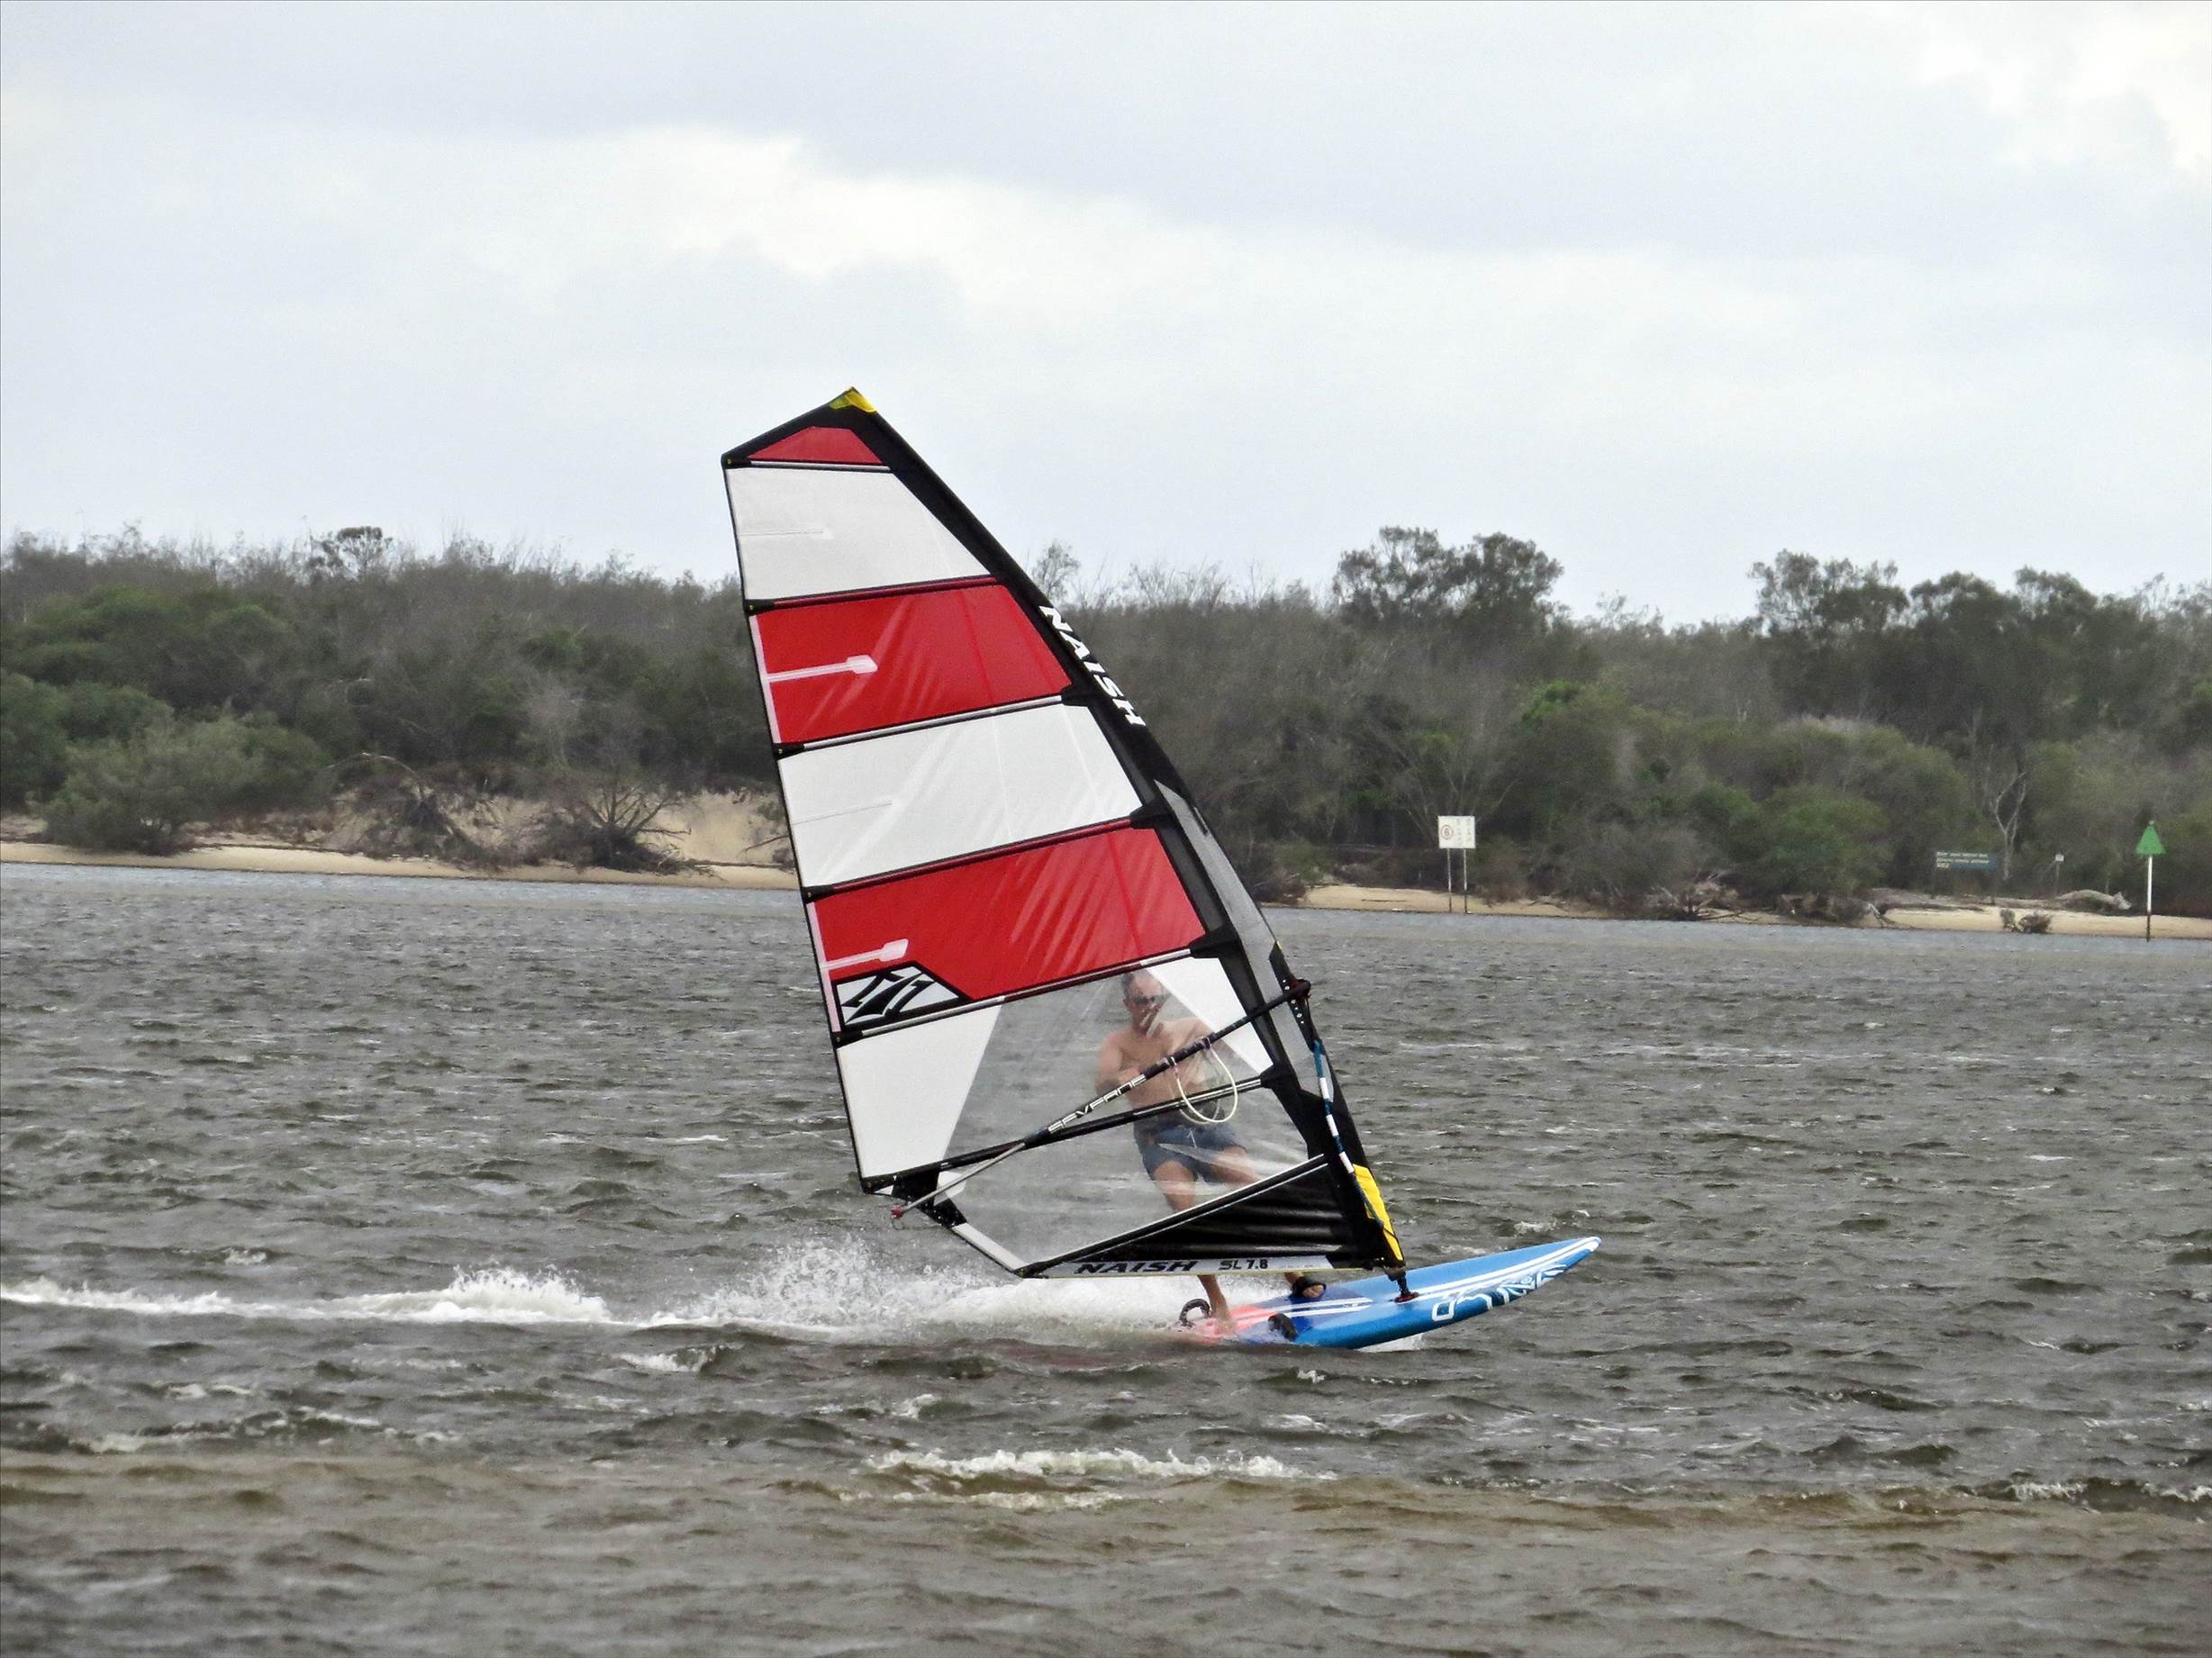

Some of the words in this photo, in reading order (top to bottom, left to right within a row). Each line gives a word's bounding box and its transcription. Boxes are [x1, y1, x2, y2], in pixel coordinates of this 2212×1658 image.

[1039, 605, 1146, 726] NAISH
[1074, 1261, 1198, 1274] NAISH
[1218, 1260, 1241, 1270] SL
[1247, 1259, 1269, 1270] 7.8
